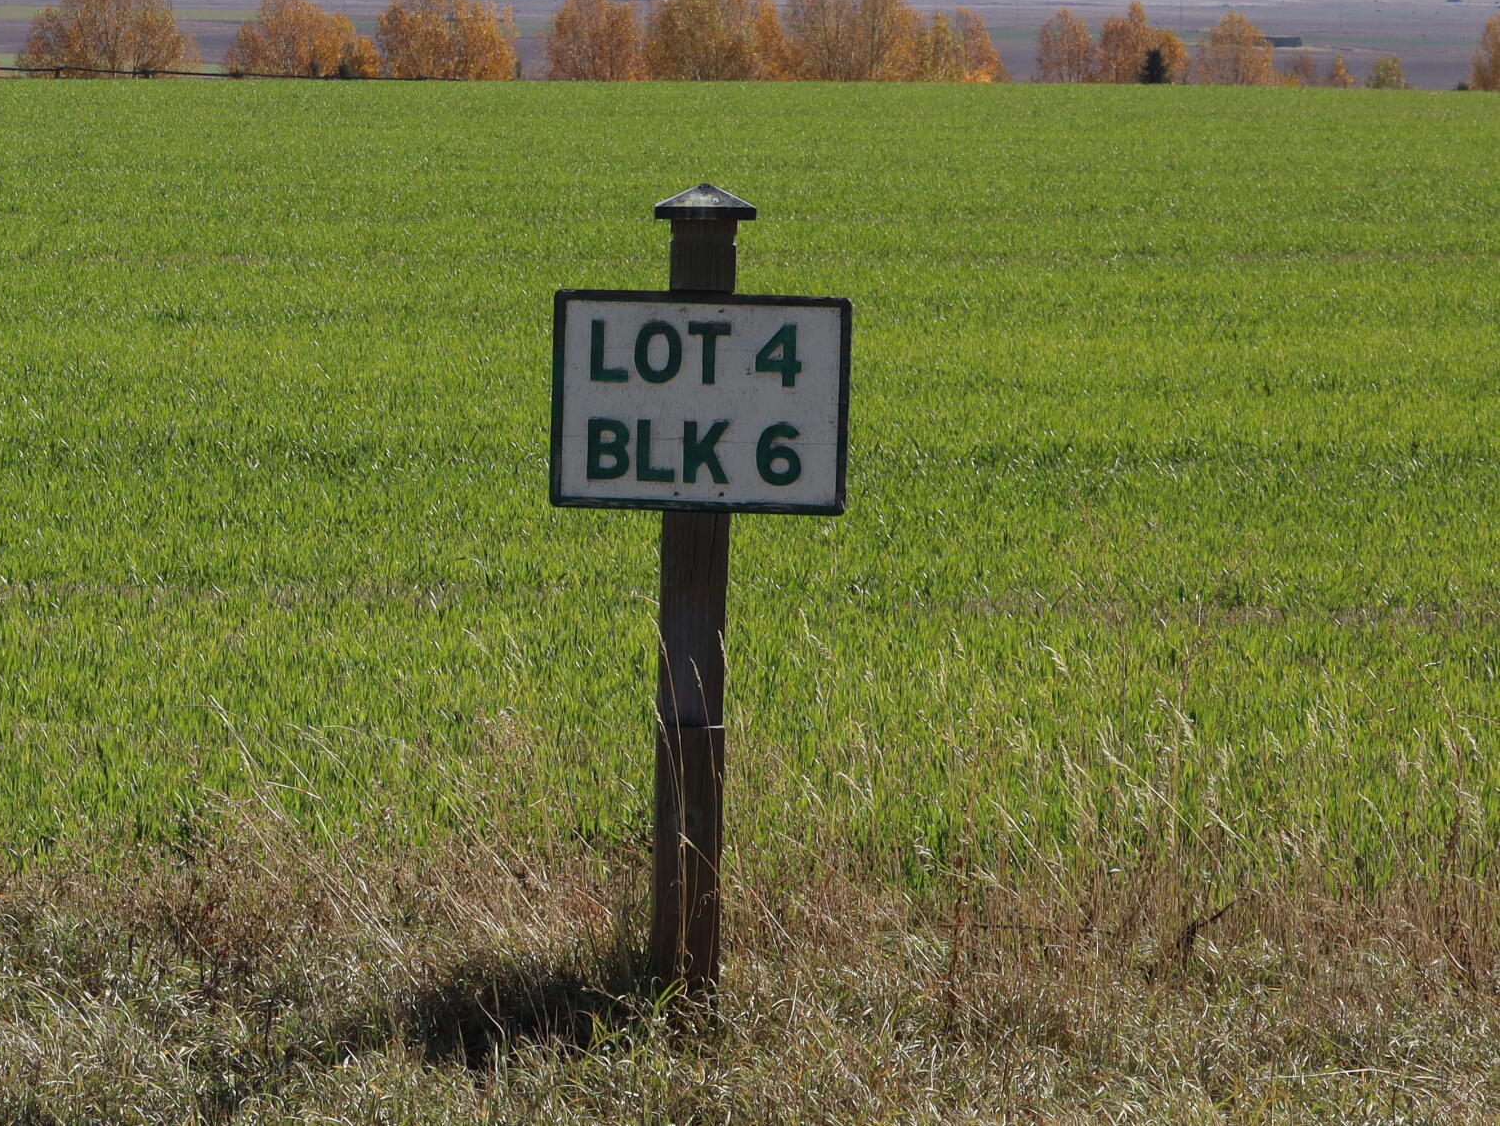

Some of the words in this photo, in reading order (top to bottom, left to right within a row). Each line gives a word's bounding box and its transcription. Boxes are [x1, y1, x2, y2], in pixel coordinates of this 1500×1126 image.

[590, 319, 732, 385] LOT
[754, 324, 802, 387] 4
[587, 417, 730, 485] BLK
[756, 421, 801, 486] 6
